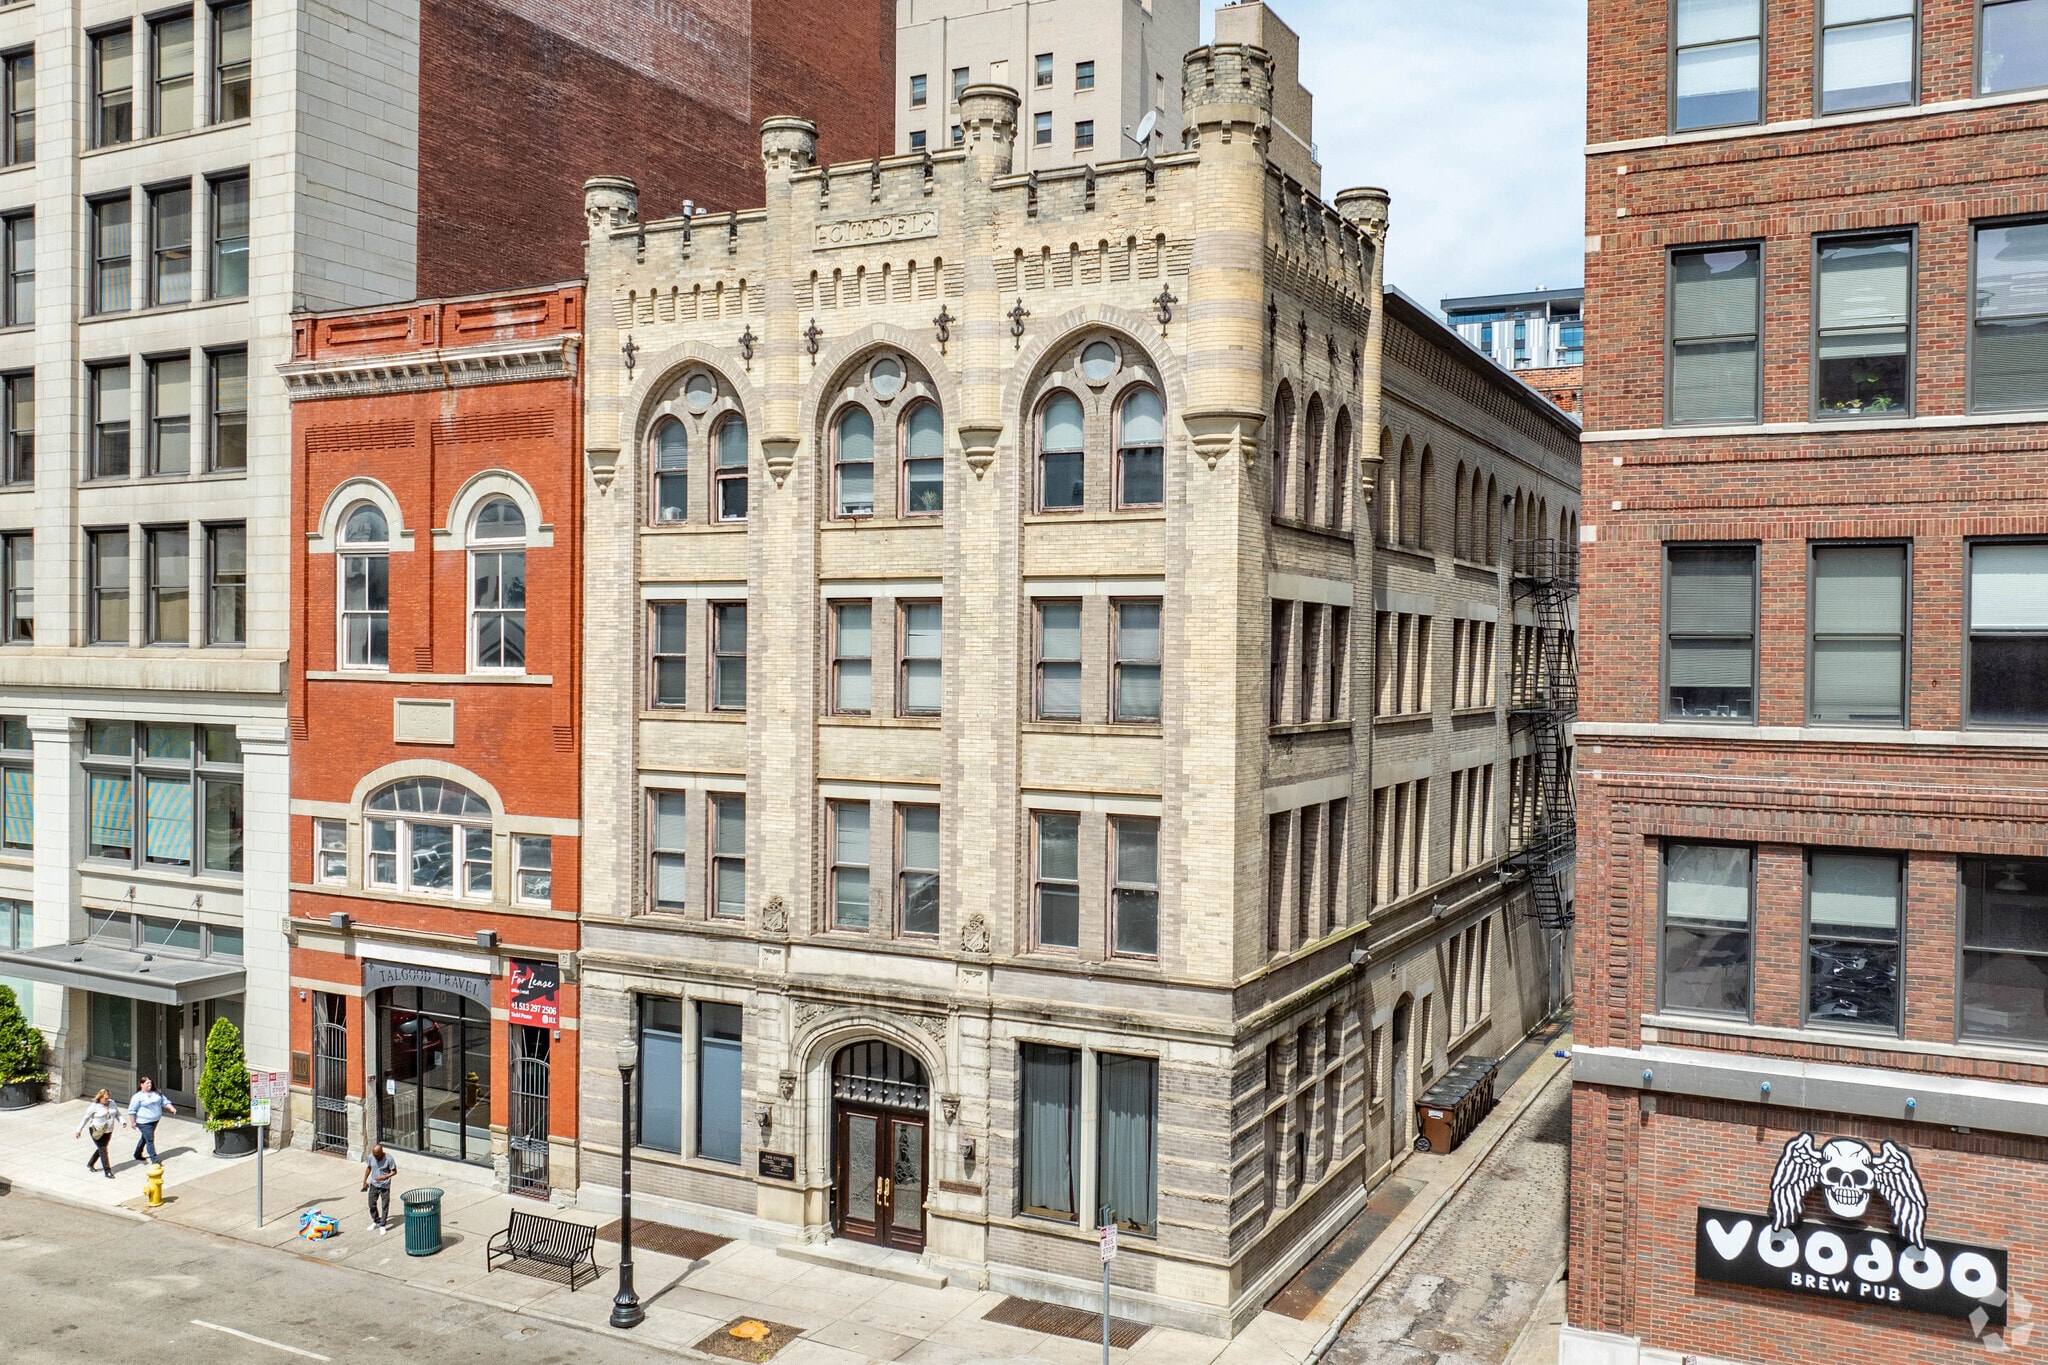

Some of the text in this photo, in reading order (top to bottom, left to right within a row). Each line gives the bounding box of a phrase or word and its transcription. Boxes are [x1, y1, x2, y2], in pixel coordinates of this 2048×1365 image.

[830, 215, 924, 243] CITADEL
[379, 968, 480, 996] TALGOOD TRAVEL
[511, 969, 555, 989] For Lease
[519, 1002, 530, 1011] 513
[530, 1004, 541, 1013] 297
[542, 1006, 557, 1015] 2506
[1102, 1245, 1115, 1256] STOP
[1103, 1238, 1114, 1247] BUS
[1791, 1271, 1902, 1302] BREW PUB
